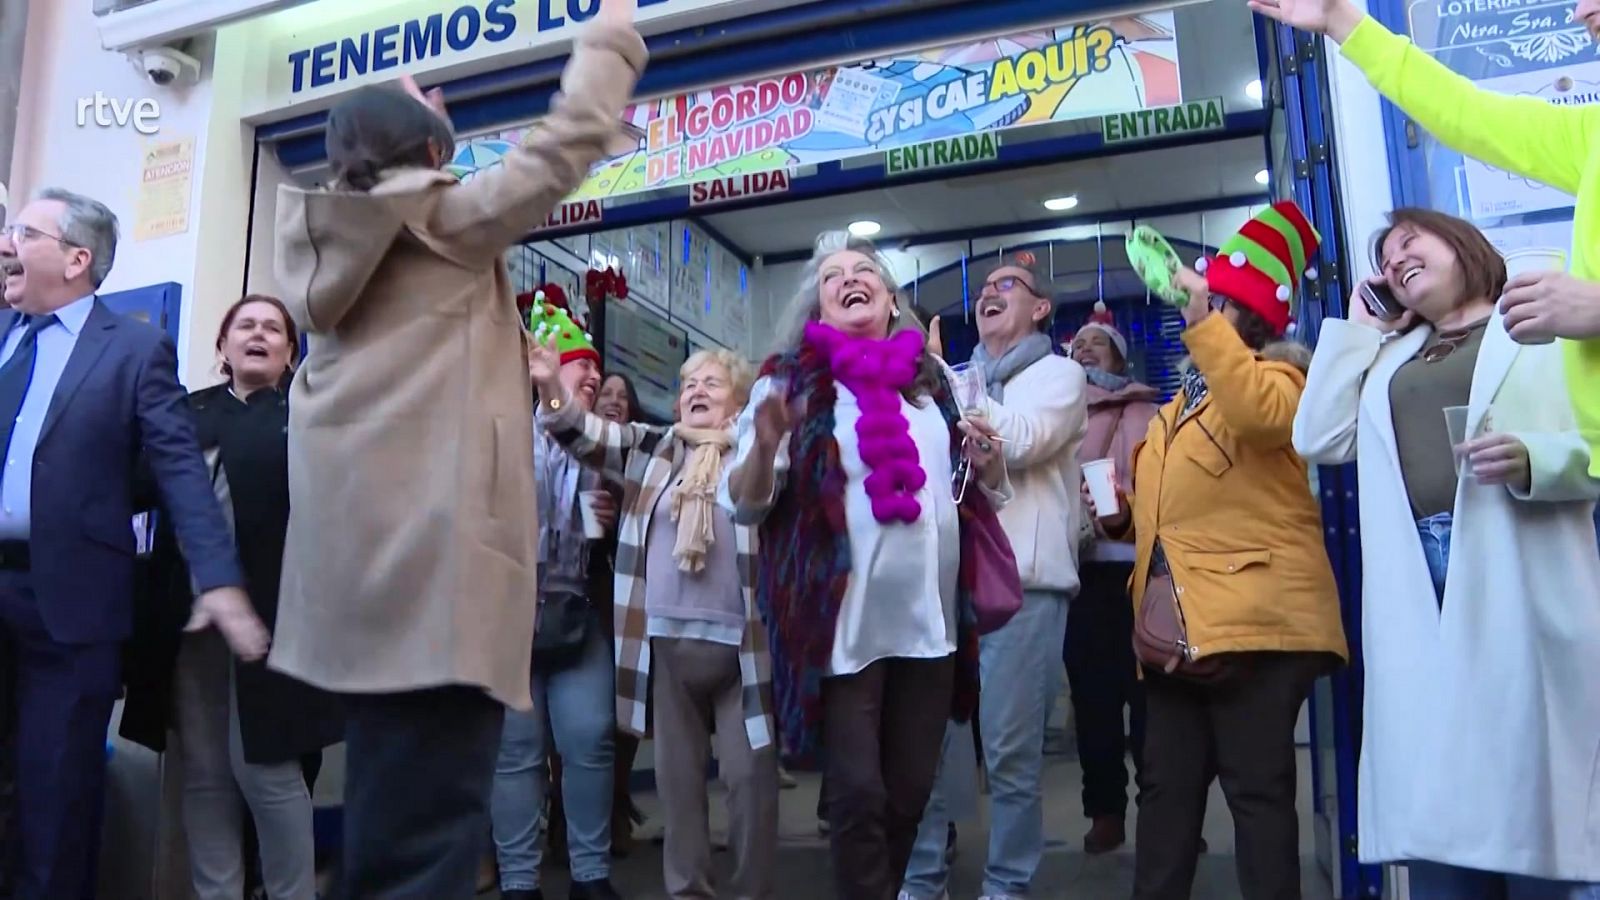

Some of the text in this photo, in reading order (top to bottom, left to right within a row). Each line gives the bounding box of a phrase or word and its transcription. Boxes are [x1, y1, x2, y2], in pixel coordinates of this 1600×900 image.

[288, 0, 517, 94] TENEMOS
[926, 72, 985, 119] CAE
[989, 26, 1112, 101] AQUÍ?
[688, 73, 807, 136] GORDO
[1105, 102, 1223, 140] ENTRADA
[648, 109, 813, 182] DE NAVIDAD
[888, 136, 996, 172] ENTRADA
[692, 170, 789, 202] SALIDA
